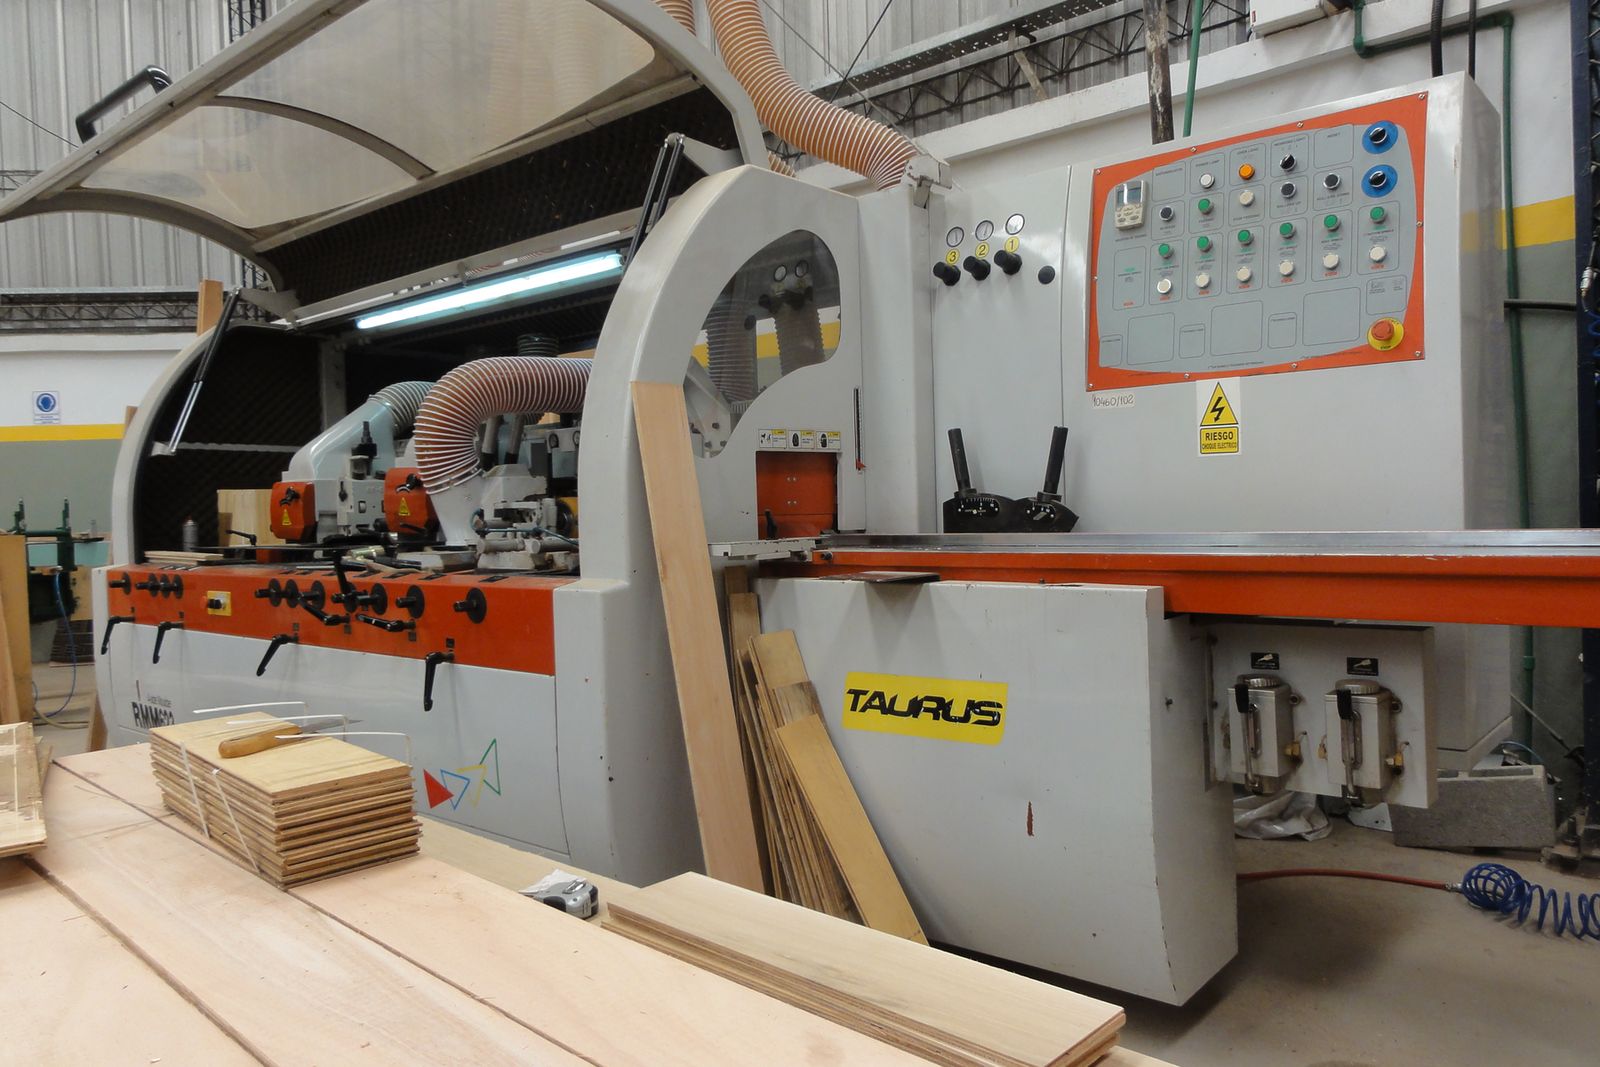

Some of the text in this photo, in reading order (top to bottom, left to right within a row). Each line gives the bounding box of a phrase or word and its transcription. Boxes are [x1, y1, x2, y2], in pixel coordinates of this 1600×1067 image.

[978, 244, 987, 256] 2
[948, 250, 958, 263] 3
[1205, 431, 1234, 441] RIESGO
[846, 688, 1003, 727] TAURUS
